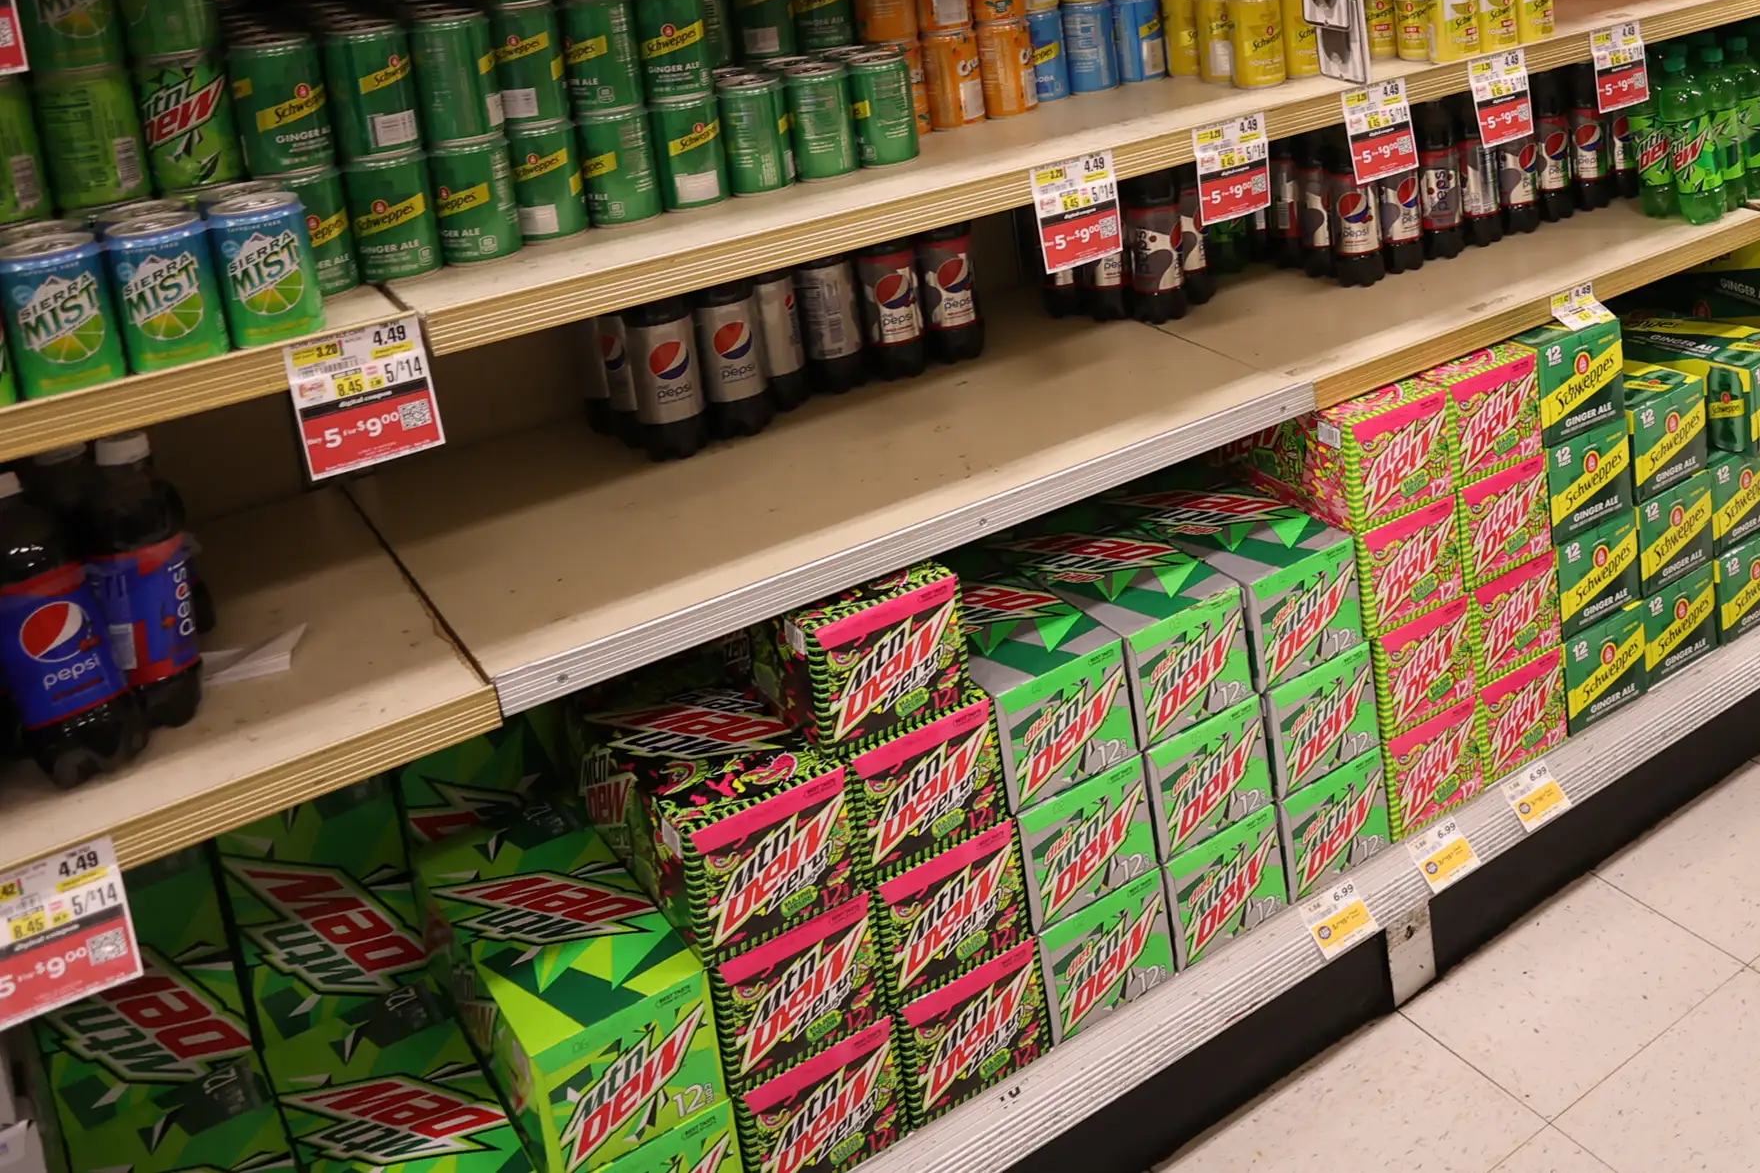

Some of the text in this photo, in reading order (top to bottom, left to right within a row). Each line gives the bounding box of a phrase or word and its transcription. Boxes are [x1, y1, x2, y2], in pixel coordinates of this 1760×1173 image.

[648, 63, 683, 73] GINGER
[1240, 118, 1258, 133] 4.49
[276, 133, 319, 144] GINGER
[1084, 156, 1105, 172] 4.49
[1340, 225, 1369, 239] pepsi
[227, 229, 292, 275] SIERRA
[399, 239, 419, 250] ALE
[124, 253, 191, 299] SIERRA
[232, 241, 299, 301] MIST
[21, 272, 92, 322] SIERRA
[127, 263, 196, 324] MIST
[1719, 277, 1755, 299] GINGER
[25, 283, 97, 345] MIST
[882, 312, 915, 327] pepsi
[373, 325, 406, 345] 4.49
[1545, 344, 1562, 361] 12
[337, 381, 363, 397] 8.45
[657, 386, 692, 402] pepsi
[1555, 353, 1615, 415] Schweppes
[1565, 408, 1597, 428] GINGER
[1598, 402, 1612, 415] ALE
[324, 428, 343, 448] 5
[1566, 452, 1623, 512] Schweppes
[1573, 496, 1620, 524] GINGER ALE
[178, 558, 194, 637] pepsi
[42, 653, 101, 691] pepsi
[1098, 740, 1120, 764] 12
[1529, 766, 1547, 782] 6.99
[1437, 822, 1456, 839] 6.99
[58, 850, 100, 878] 4.49
[1333, 884, 1354, 902] 6.99
[570, 1045, 644, 1134] Mtn
[672, 1084, 705, 1118] 12
